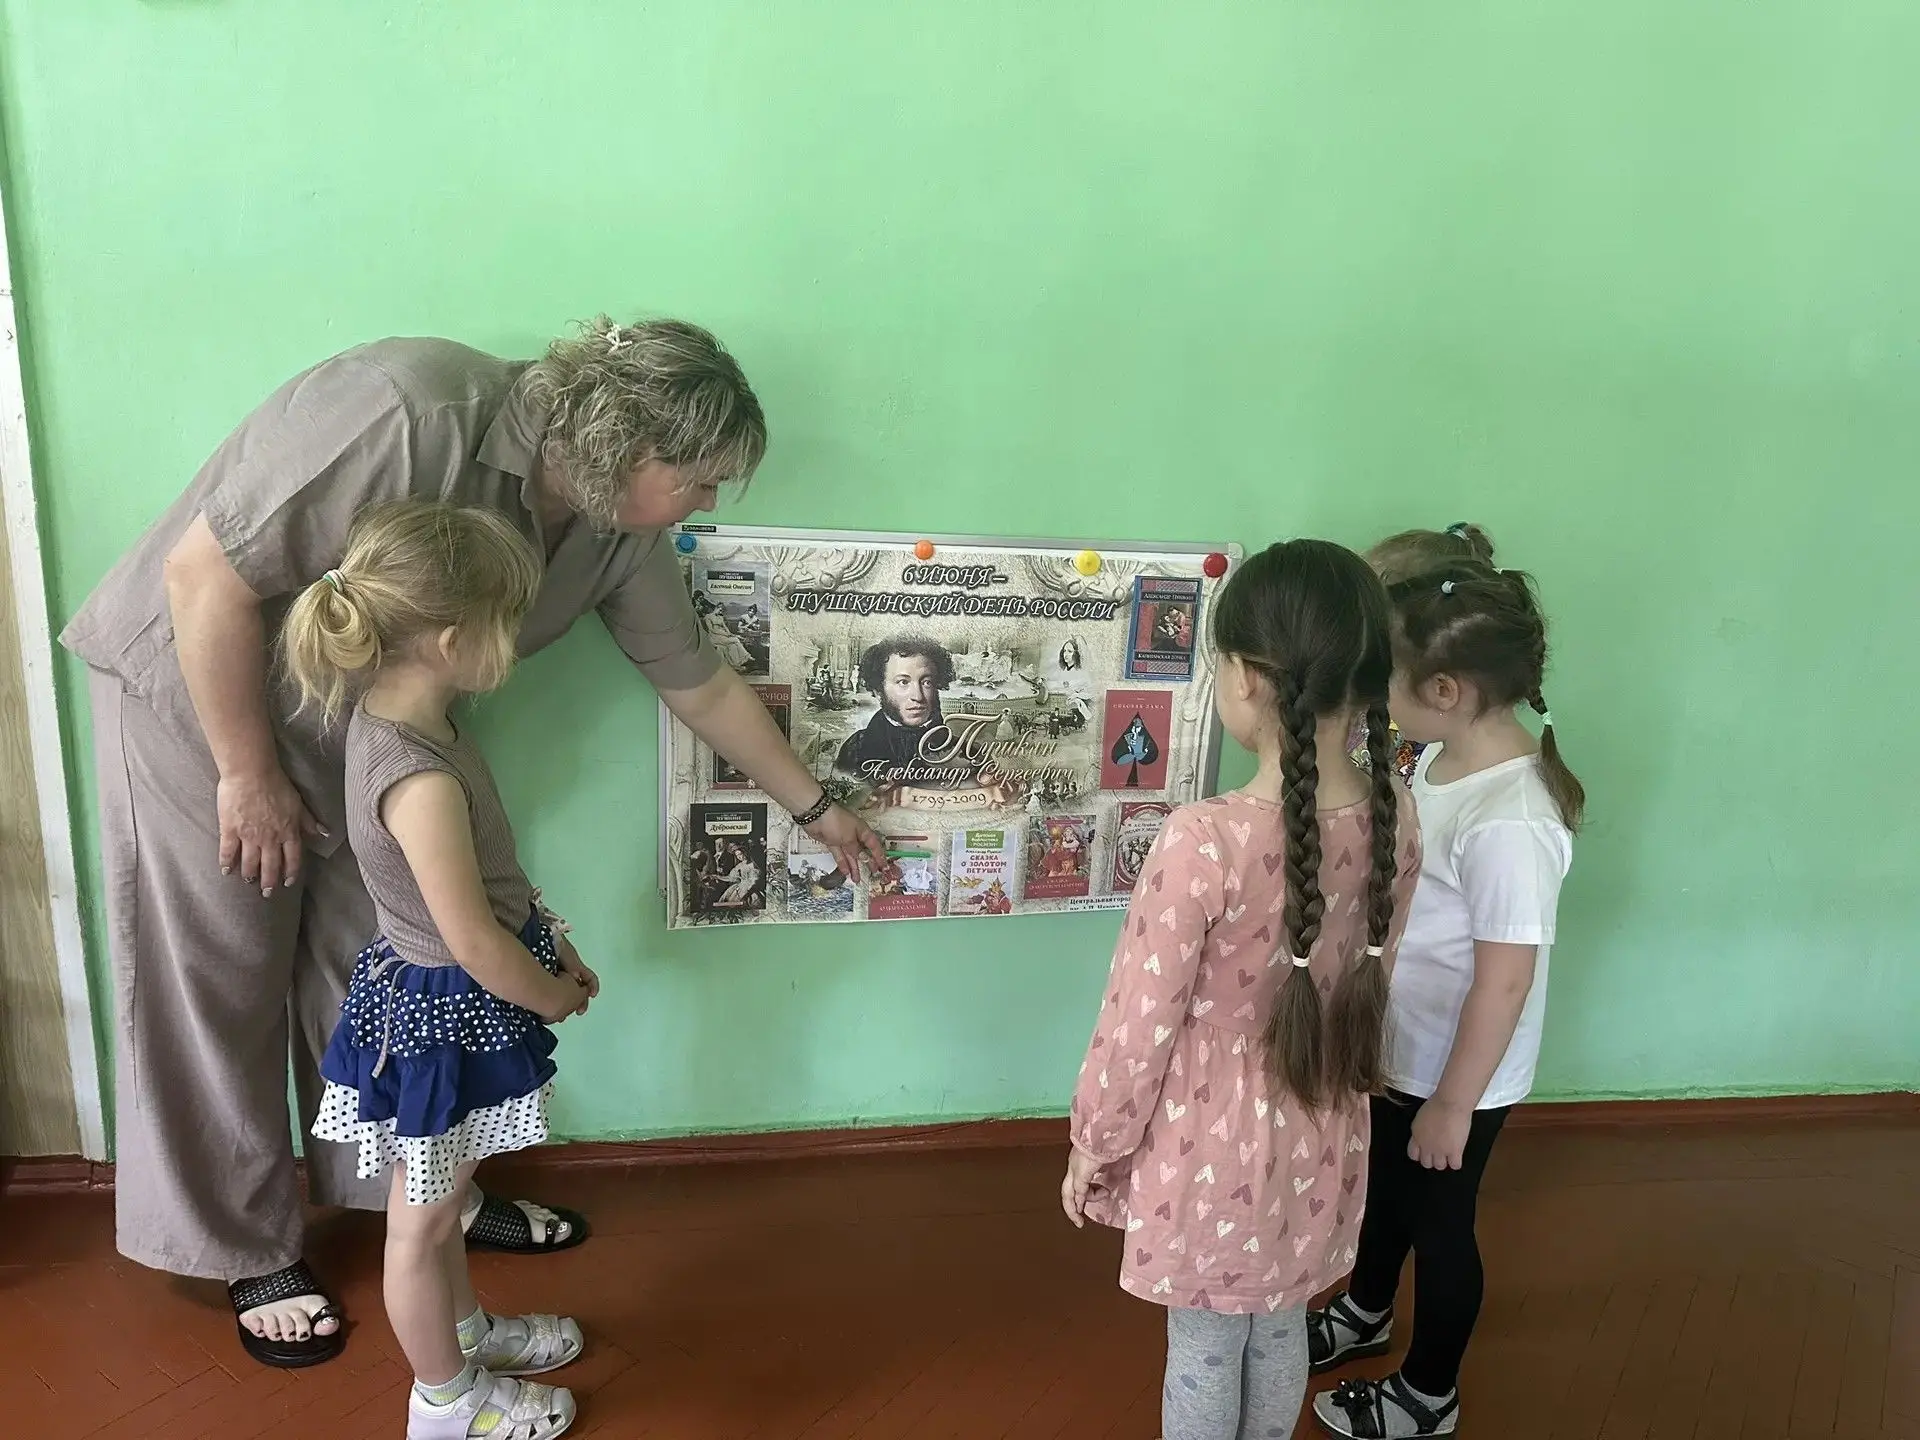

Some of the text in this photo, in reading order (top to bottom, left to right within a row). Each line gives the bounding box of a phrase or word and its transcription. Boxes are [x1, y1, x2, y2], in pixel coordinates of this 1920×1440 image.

[903, 566, 916, 583] 6
[917, 566, 994, 588] ИЮНЯ
[788, 591, 1118, 619] ПУШКИНСКИЙ ДЕНЬ РОССИИ
[918, 713, 1057, 767] Пушкин
[853, 755, 1074, 789] Александр Сергеевич
[911, 793, 987, 809] 1799-2009
[710, 823, 748, 832] Дубровский
